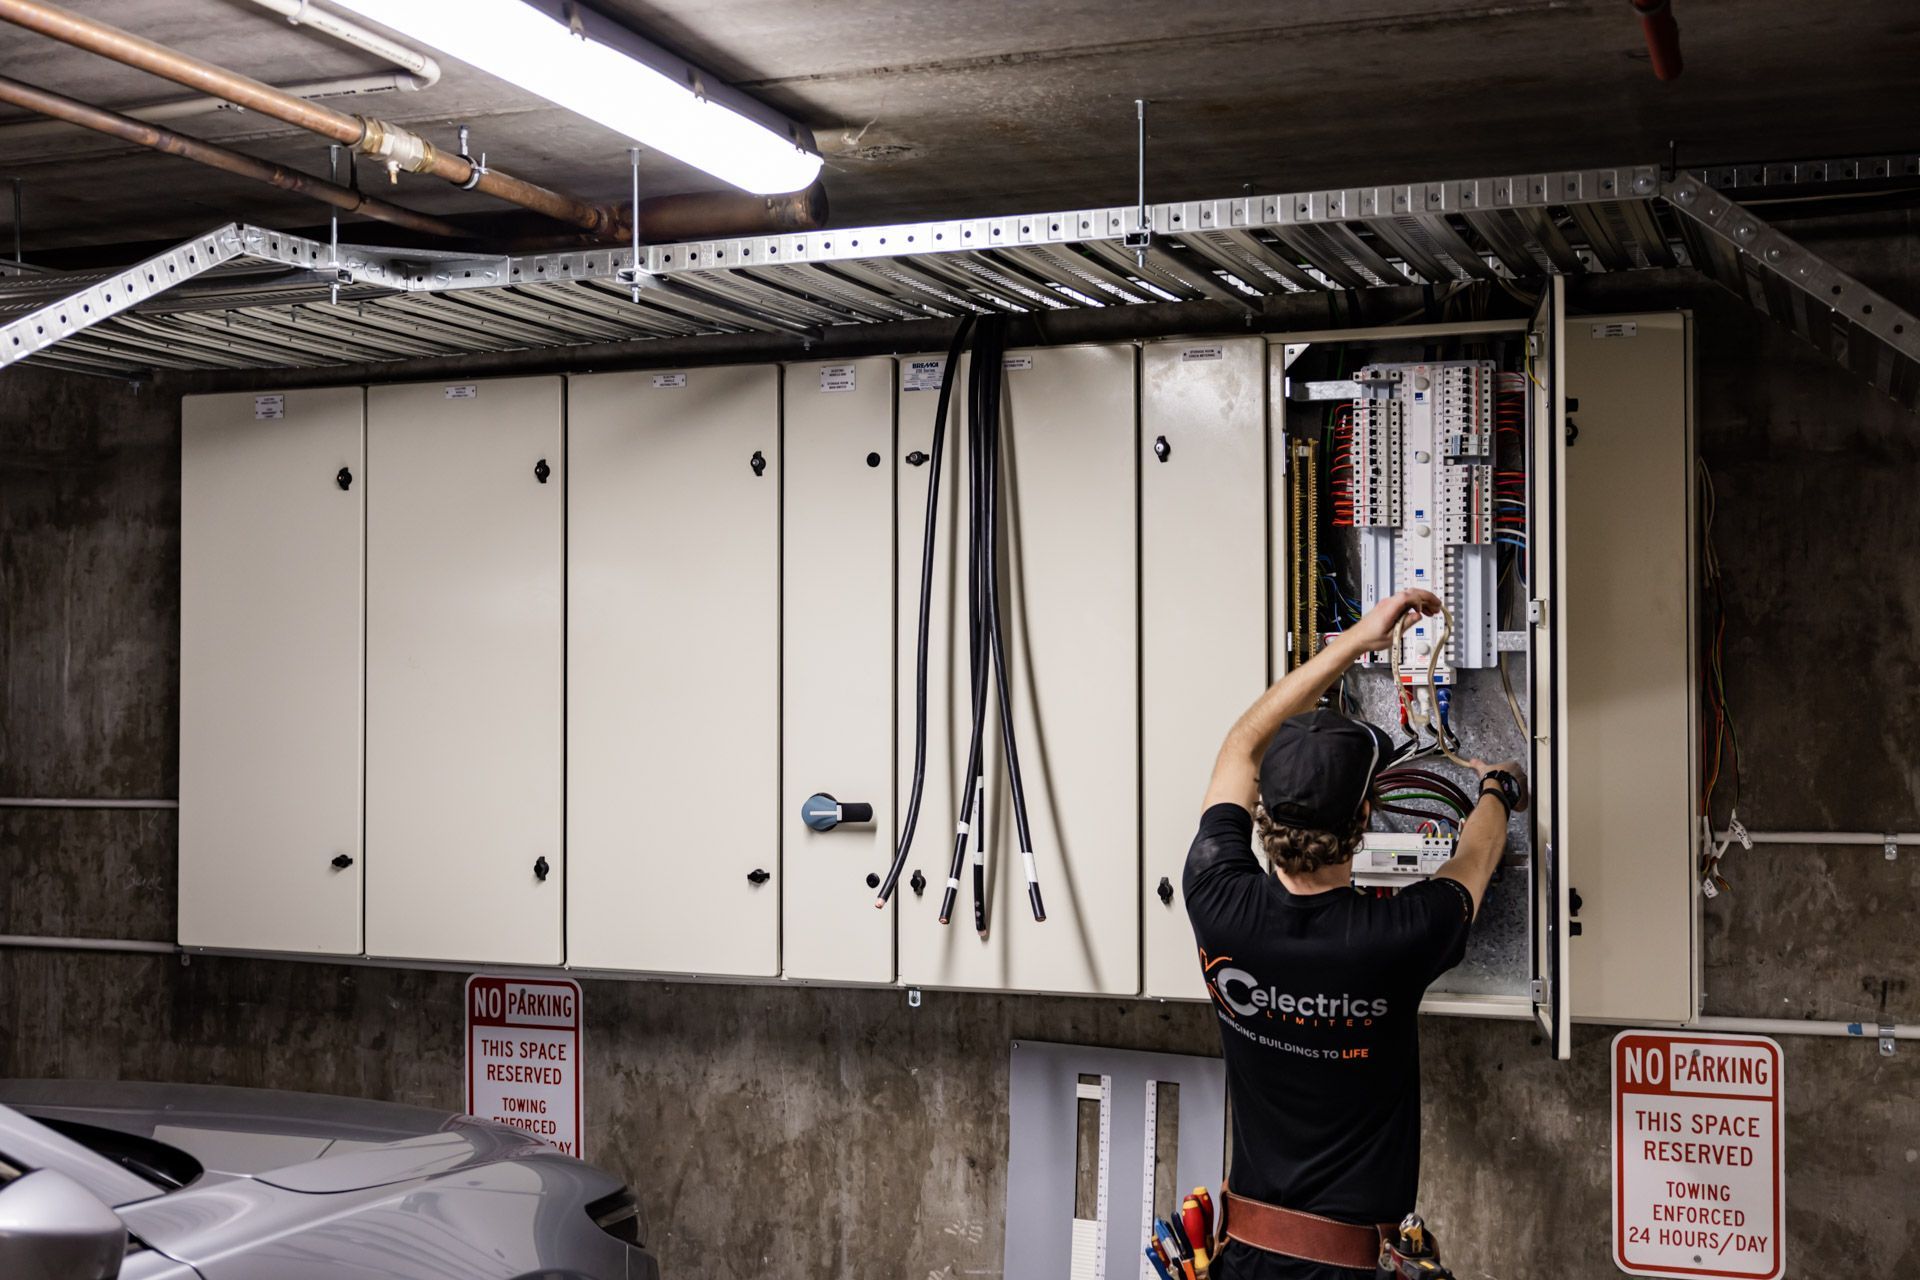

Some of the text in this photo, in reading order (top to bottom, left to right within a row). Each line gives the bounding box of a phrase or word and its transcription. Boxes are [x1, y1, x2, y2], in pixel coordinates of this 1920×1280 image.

[474, 987, 572, 1019] NO PARKING
[1217, 967, 1388, 1016] Celectrics
[1267, 1010, 1373, 1027] LIMITED
[481, 1039, 567, 1061] THIS SPACE
[1259, 1035, 1320, 1059] BUILDINGS
[1322, 1050, 1339, 1060] TO
[1342, 1048, 1369, 1060] LIFE
[487, 1064, 562, 1085] RESERVED
[1625, 1046, 1768, 1085] NO PARKING
[502, 1097, 546, 1114] TOWING
[1636, 1110, 1760, 1138] THIS SPACE
[1644, 1140, 1753, 1167] RESERVED
[1666, 1181, 1731, 1202] TOWING
[1653, 1204, 1745, 1227] ENFORCED
[1629, 1227, 1768, 1256] 24 HOURS/DAY
